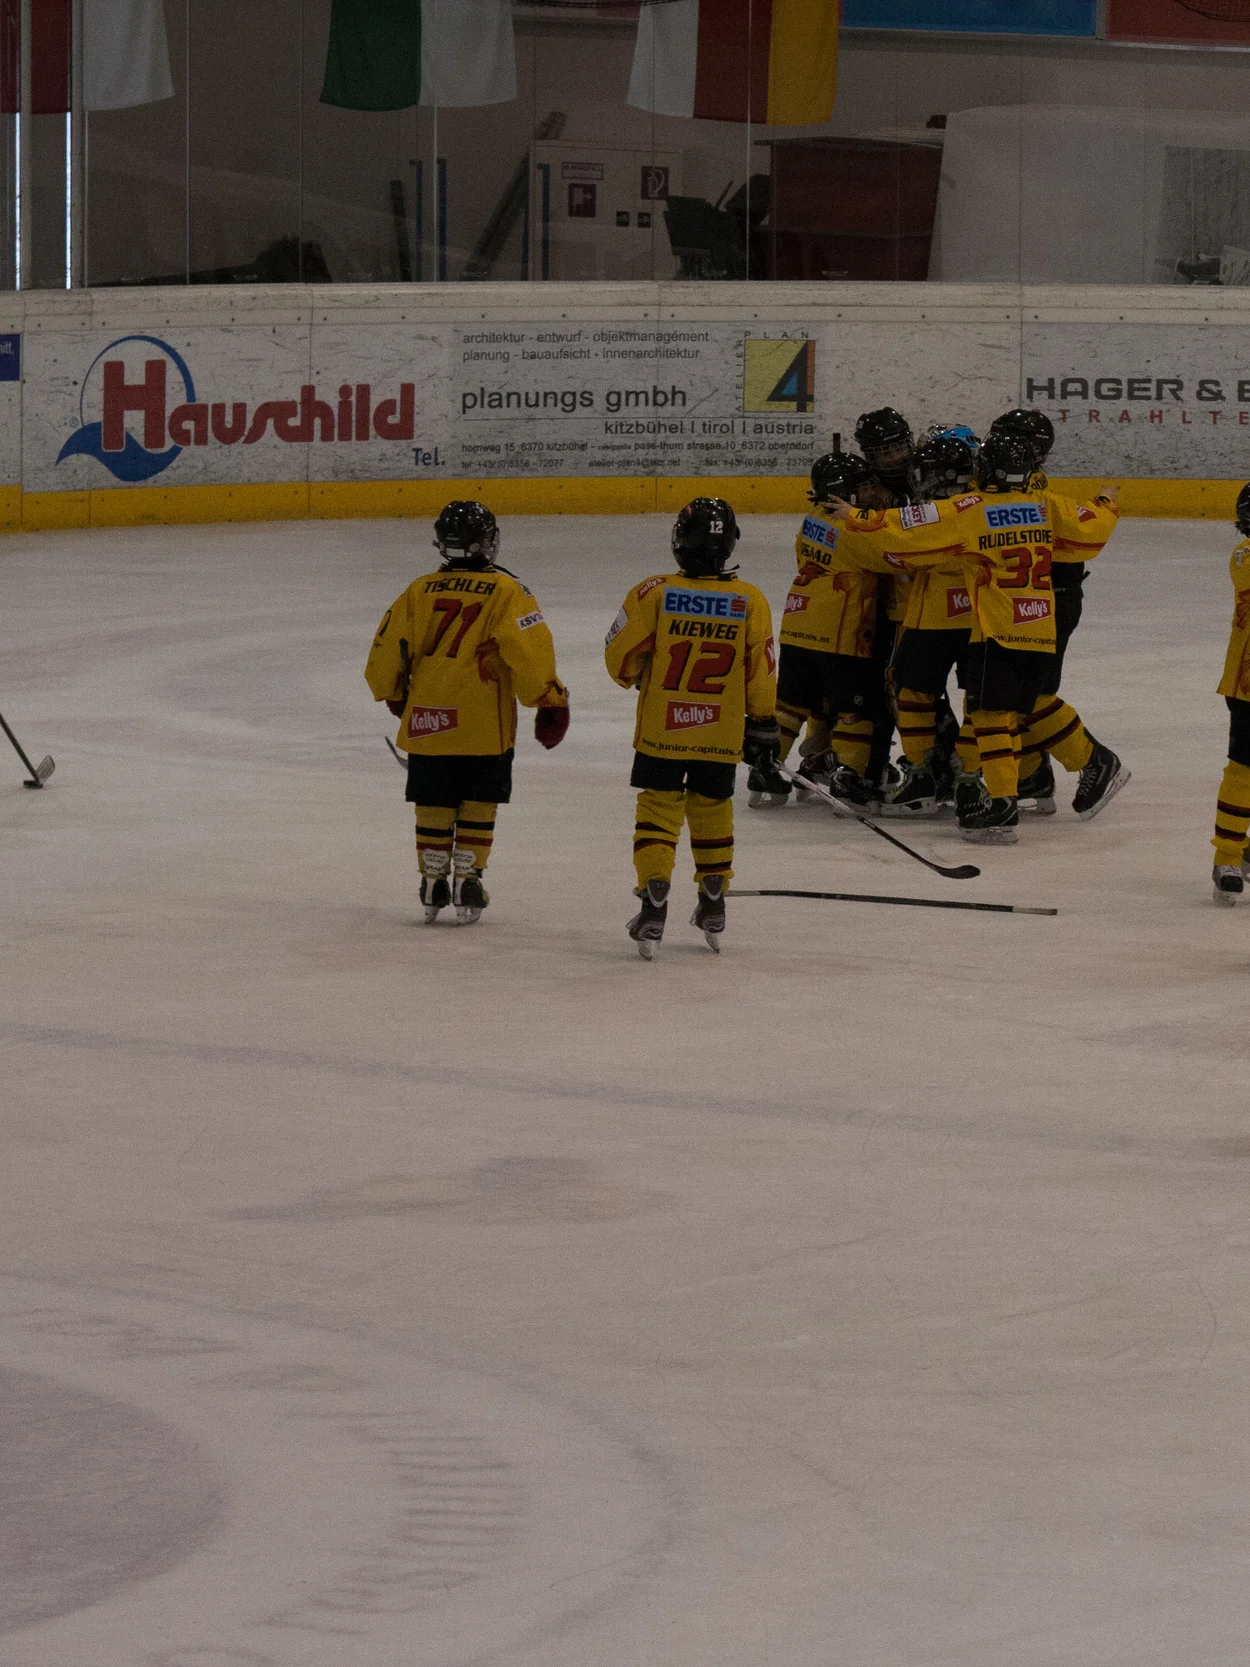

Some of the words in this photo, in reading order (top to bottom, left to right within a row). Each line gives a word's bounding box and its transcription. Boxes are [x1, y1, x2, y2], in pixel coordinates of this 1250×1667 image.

[463, 331, 525, 344] architektur
[537, 331, 582, 343] entwurf
[593, 330, 709, 345] objektmanagement
[463, 350, 510, 363] planung
[522, 349, 591, 360] bauaufsicht
[602, 347, 700, 360] innenarchitektur
[1026, 377, 1185, 402] HAGER
[1195, 379, 1227, 402] &
[102, 359, 415, 451] Hauschild
[462, 386, 594, 415] planungs
[605, 385, 687, 414] gmbh
[605, 420, 684, 435] kitzbühel
[702, 420, 735, 435] tirol
[753, 421, 815, 435] austria
[546, 441, 588, 451] kitzbühel
[412, 447, 446, 466] Tel.
[709, 520, 724, 534] 12
[986, 508, 1040, 527] ERSTE
[997, 546, 1053, 590] 32
[424, 577, 498, 596] TISCHLER
[665, 592, 729, 616] ERSTE
[1018, 599, 1048, 617] Kelly's
[668, 619, 739, 640] KIEWEG
[662, 639, 737, 695] 12
[410, 710, 451, 732] Kelly's
[672, 704, 715, 726] Kelly's
